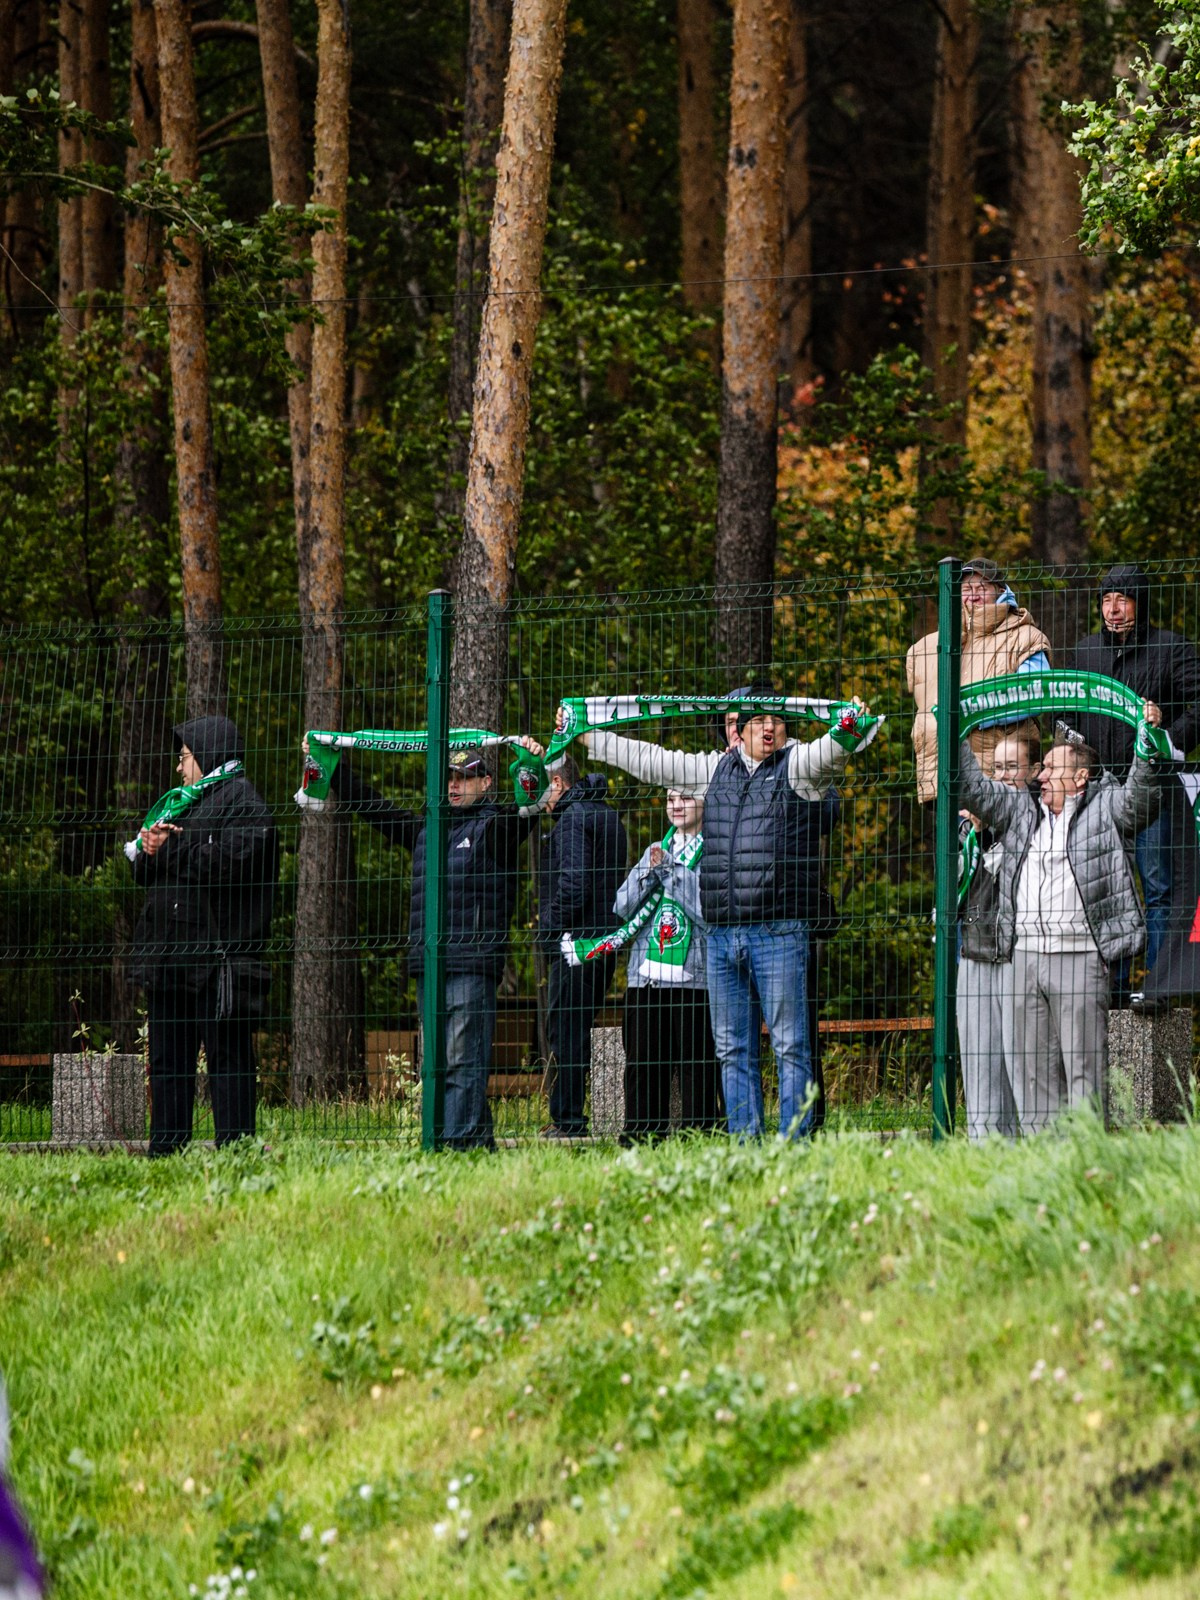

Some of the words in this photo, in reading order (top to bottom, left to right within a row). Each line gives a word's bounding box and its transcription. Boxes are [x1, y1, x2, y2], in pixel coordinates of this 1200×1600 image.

[959, 679, 1042, 718] ТБОЛЬНЫЙ
[1047, 682, 1085, 699] КЛУБ
[357, 739, 428, 751] ФУТБОЛЬНЫ
